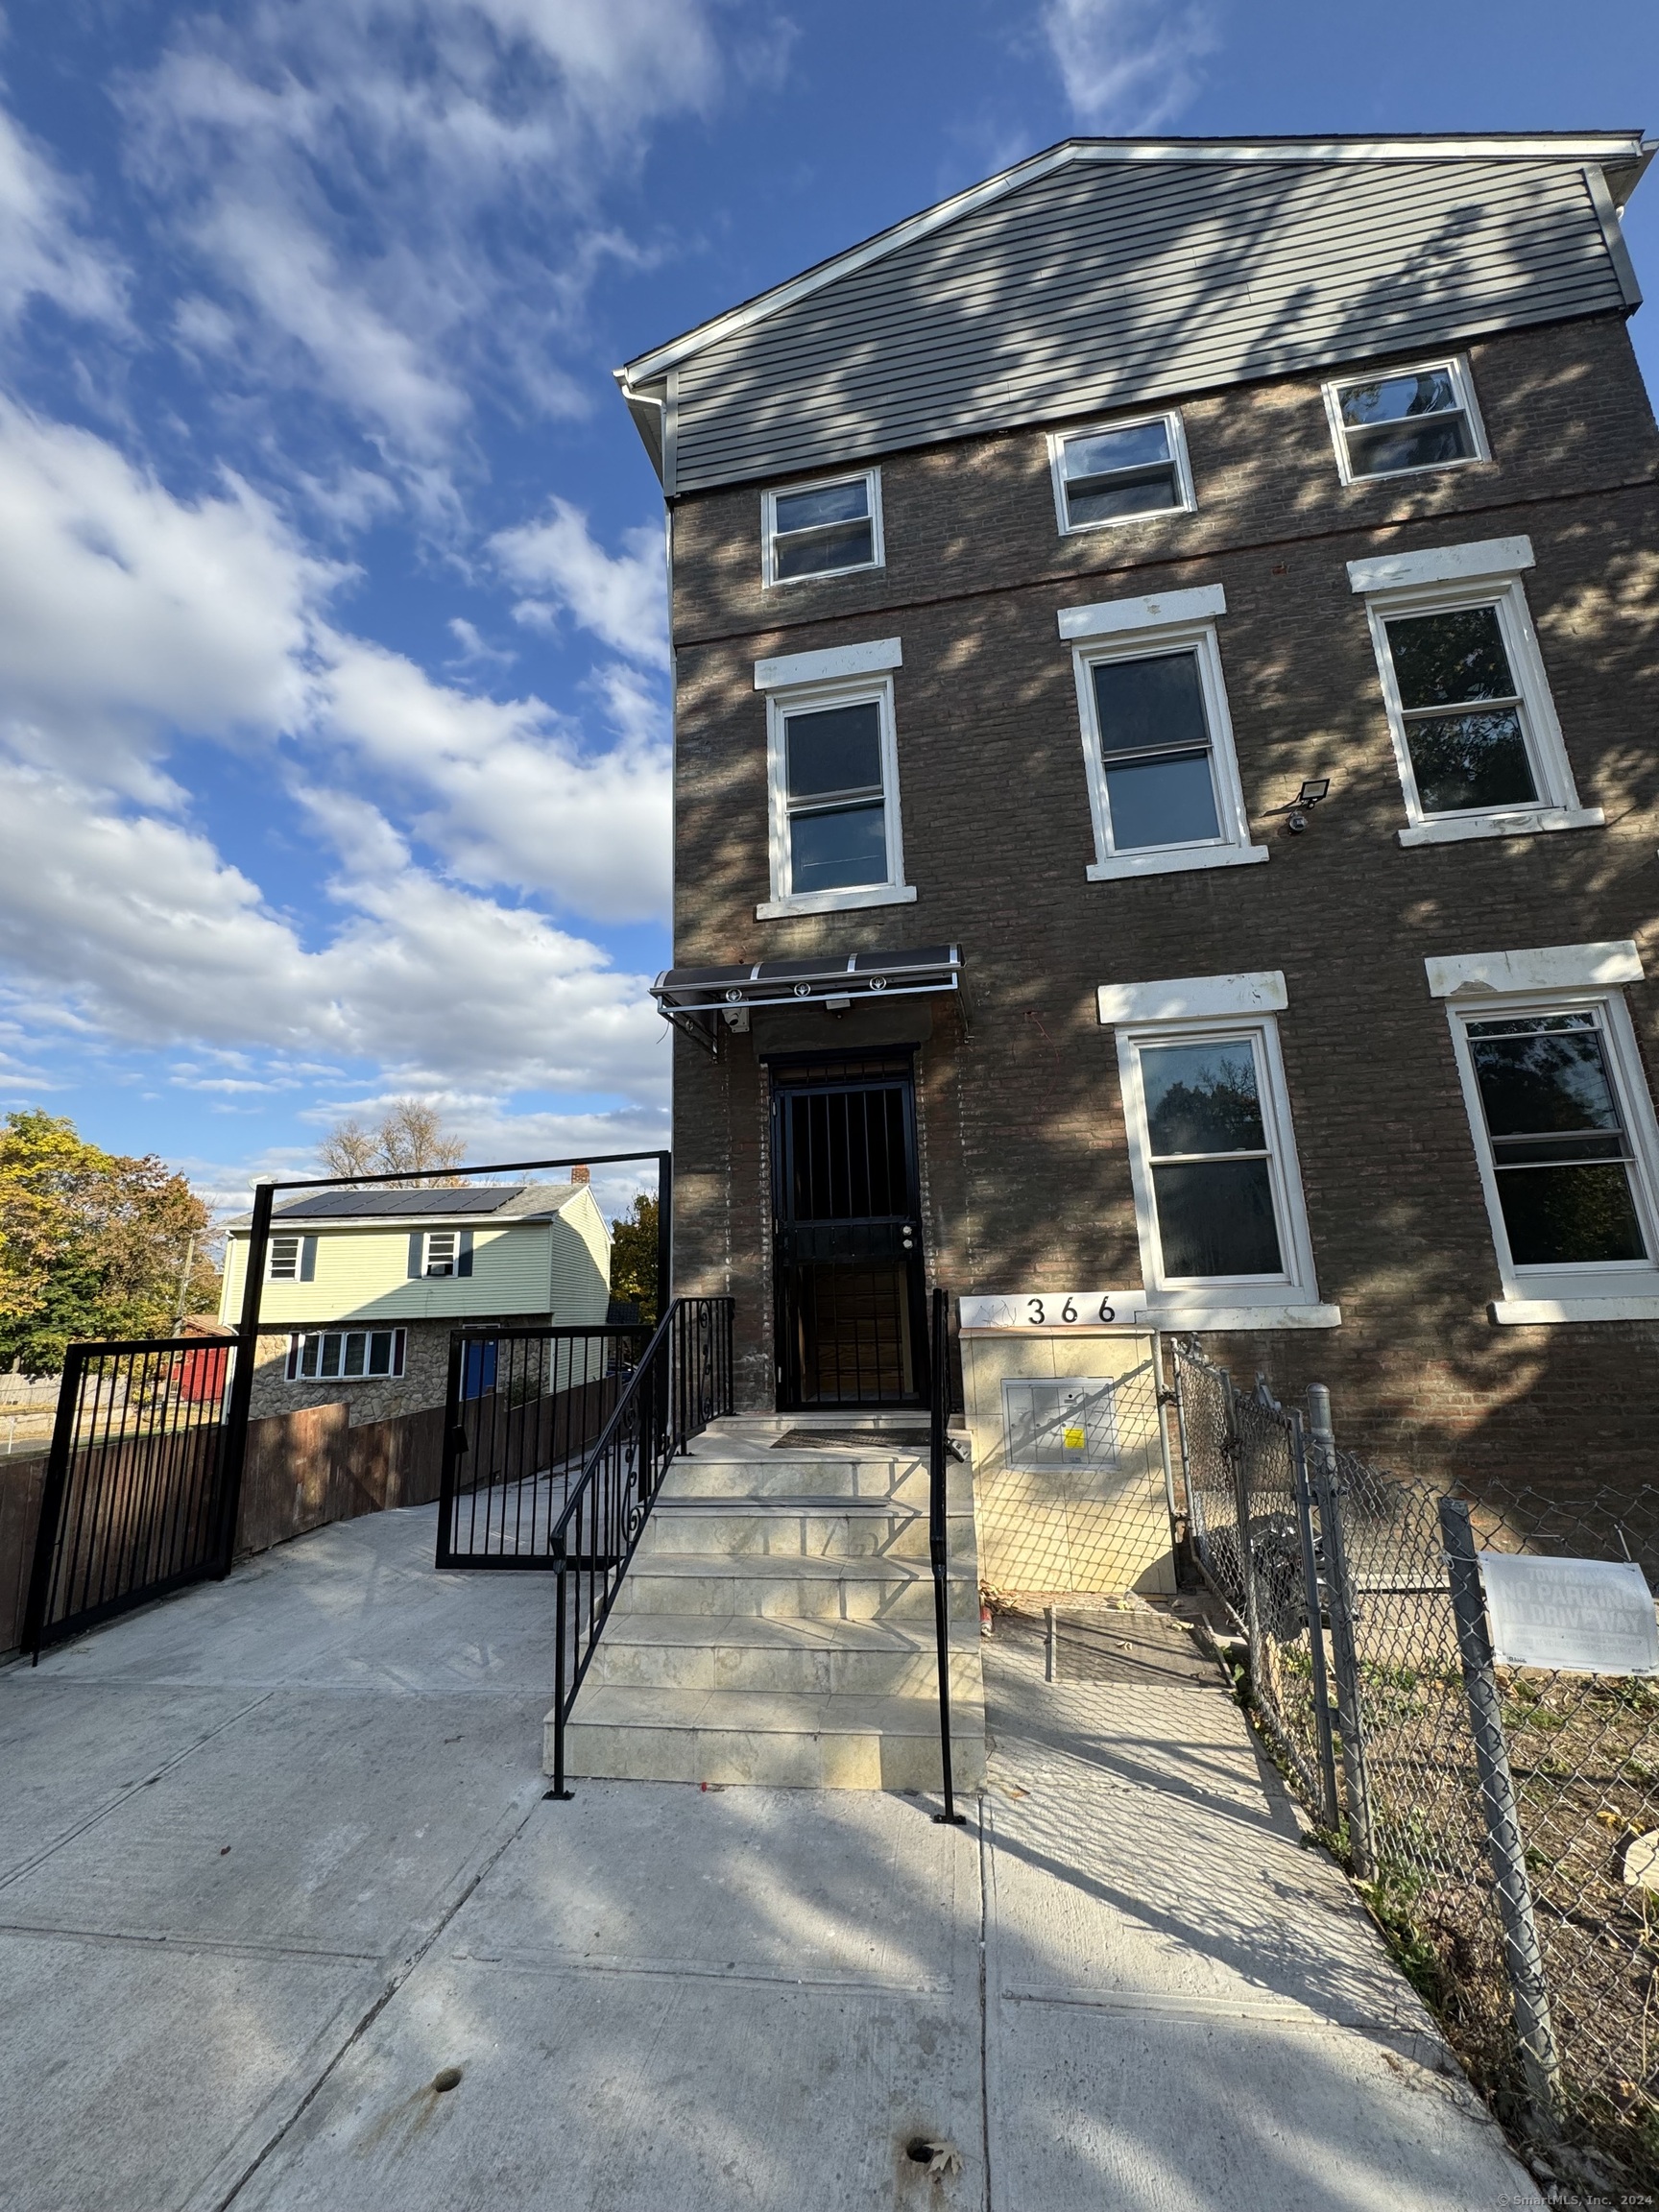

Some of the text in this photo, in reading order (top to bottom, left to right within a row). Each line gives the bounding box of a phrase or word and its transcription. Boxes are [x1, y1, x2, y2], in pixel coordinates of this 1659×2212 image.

[1027, 1295, 1116, 1325] 366
[1527, 1568, 1560, 1583] TOW
[1499, 1579, 1640, 1612] NO PARKING
[1500, 1600, 1640, 1633] IN DRIVEWAY
